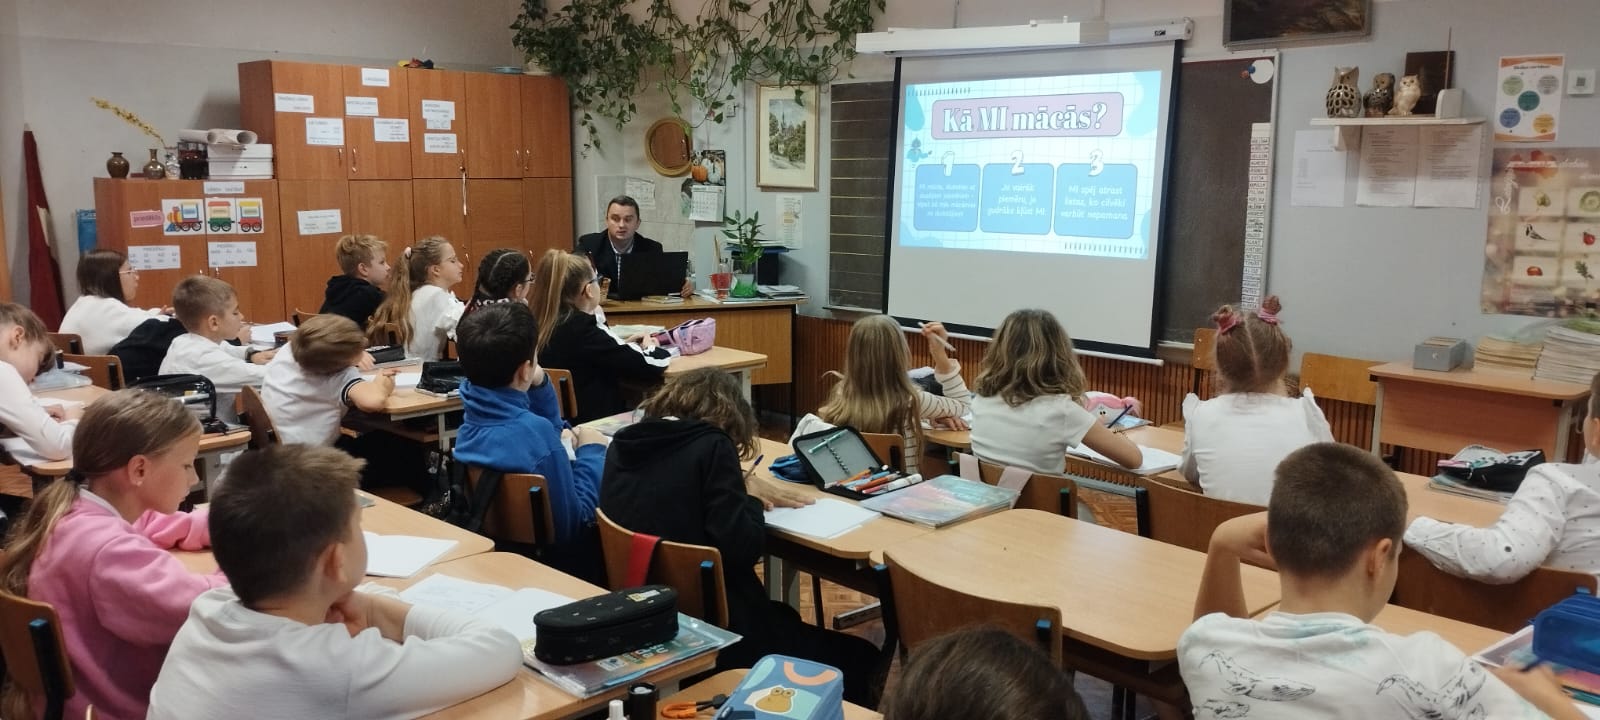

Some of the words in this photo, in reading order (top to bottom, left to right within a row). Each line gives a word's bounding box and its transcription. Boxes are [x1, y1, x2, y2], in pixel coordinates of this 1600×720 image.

[943, 107, 973, 132] Kā
[978, 106, 1008, 131] MI
[1011, 102, 1107, 130] mācās?
[941, 151, 955, 176] 1
[1011, 150, 1025, 176] 2
[1088, 149, 1104, 176] 3
